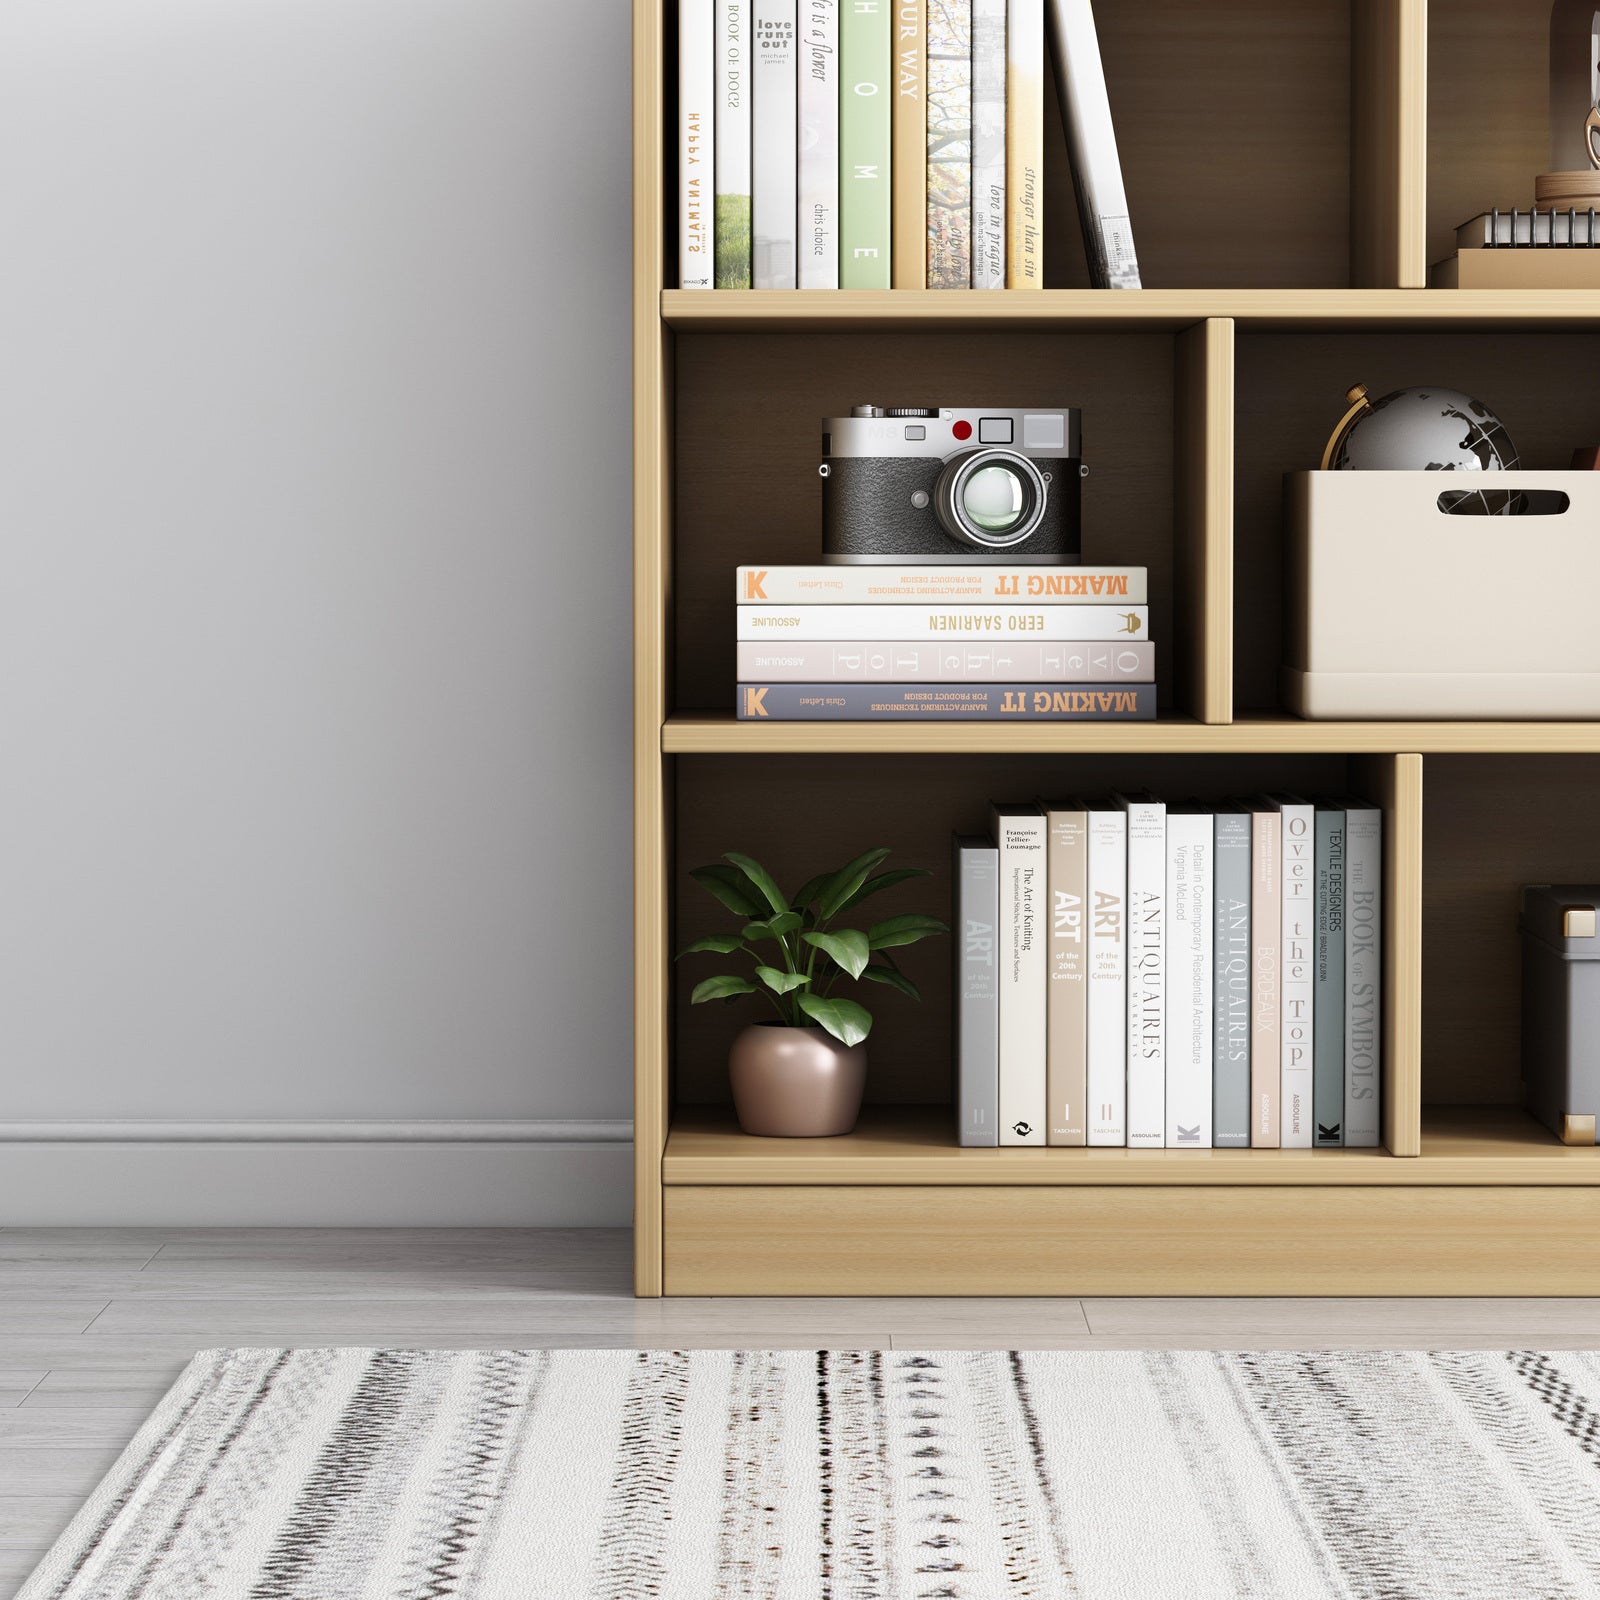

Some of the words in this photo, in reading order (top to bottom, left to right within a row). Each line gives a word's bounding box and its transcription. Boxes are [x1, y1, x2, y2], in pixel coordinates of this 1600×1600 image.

[758, 19, 792, 29] love
[811, 14, 830, 25] is
[900, 0, 919, 41] UR
[757, 31, 793, 39] runs
[811, 29, 826, 39] a
[761, 40, 788, 48] out
[803, 38, 833, 82] flower
[900, 47, 919, 100] WAY
[990, 184, 1005, 209] love
[1019, 167, 1036, 220] stronger
[814, 203, 829, 225] chris
[976, 211, 987, 225] josh
[990, 215, 1003, 228] in
[814, 227, 829, 256] choice
[1025, 225, 1040, 254] than
[985, 231, 1003, 276] prague
[1025, 258, 1037, 278] sin
[900, 576, 929, 584] DESIGN
[930, 576, 966, 584] PRODUCT
[966, 576, 982, 584] FOR
[994, 575, 1020, 595] IT
[1027, 575, 1128, 595] MAKING
[868, 586, 915, 594] TECHNIQUES
[916, 586, 982, 594] MANUFACTURING
[752, 617, 801, 627] ASSOULINE
[929, 615, 1002, 630] SAARINEN
[1008, 615, 1044, 630] EERO
[755, 657, 805, 666] ASSOULINE
[826, 697, 846, 706] Chris
[871, 703, 919, 711] TECHNIQUES
[920, 703, 988, 711] MANUFACTURING
[1000, 692, 1026, 712] IT
[1034, 692, 1137, 712] MAKING
[1006, 829, 1038, 837] Françoise
[1006, 843, 1041, 851] Loumagne
[1289, 817, 1307, 896] Over
[1329, 828, 1342, 870] TEXTILE
[1174, 845, 1188, 881] Virginia
[1192, 844, 1205, 872] Detail
[1022, 867, 1034, 885] The
[1192, 874, 1205, 883] in
[1319, 869, 1328, 877] AT
[1353, 860, 1363, 884] THE
[1319, 879, 1328, 890] THE
[1022, 887, 1034, 902] Art
[1176, 883, 1188, 921] McLeod
[1319, 891, 1328, 915] CUTTING
[1329, 873, 1342, 932] DESIGNERS
[1022, 904, 1034, 913] of
[1054, 890, 1081, 943] ART
[1094, 890, 1121, 943] ART
[1190, 885, 1205, 952] Contemporary
[1319, 916, 1328, 931] EDGE
[1352, 889, 1375, 957] BOOK
[1020, 915, 1034, 951] Knitting
[966, 919, 993, 967] ART
[1319, 935, 1328, 962] BRADLEY
[1055, 951, 1065, 960] of
[1066, 951, 1079, 960] the
[1095, 951, 1105, 960] of
[1106, 951, 1119, 960] the
[1058, 962, 1077, 970] 20th
[1098, 962, 1116, 970] 20th
[1138, 891, 1161, 1059] ANTIQUAIRES
[1352, 962, 1363, 977] OF
[967, 973, 977, 981] of
[978, 973, 990, 981] the
[1052, 972, 1083, 982] Century
[1091, 972, 1122, 982] Century
[1192, 954, 1204, 1006] Residential
[1225, 898, 1248, 1062] ANTIQUAIRES
[1257, 946, 1275, 1034] BORDEAUX
[1192, 1008, 1204, 1065] Architecture
[1351, 983, 1375, 1101] SYMBOLS
[1293, 1093, 1301, 1135] ASSOULINE
